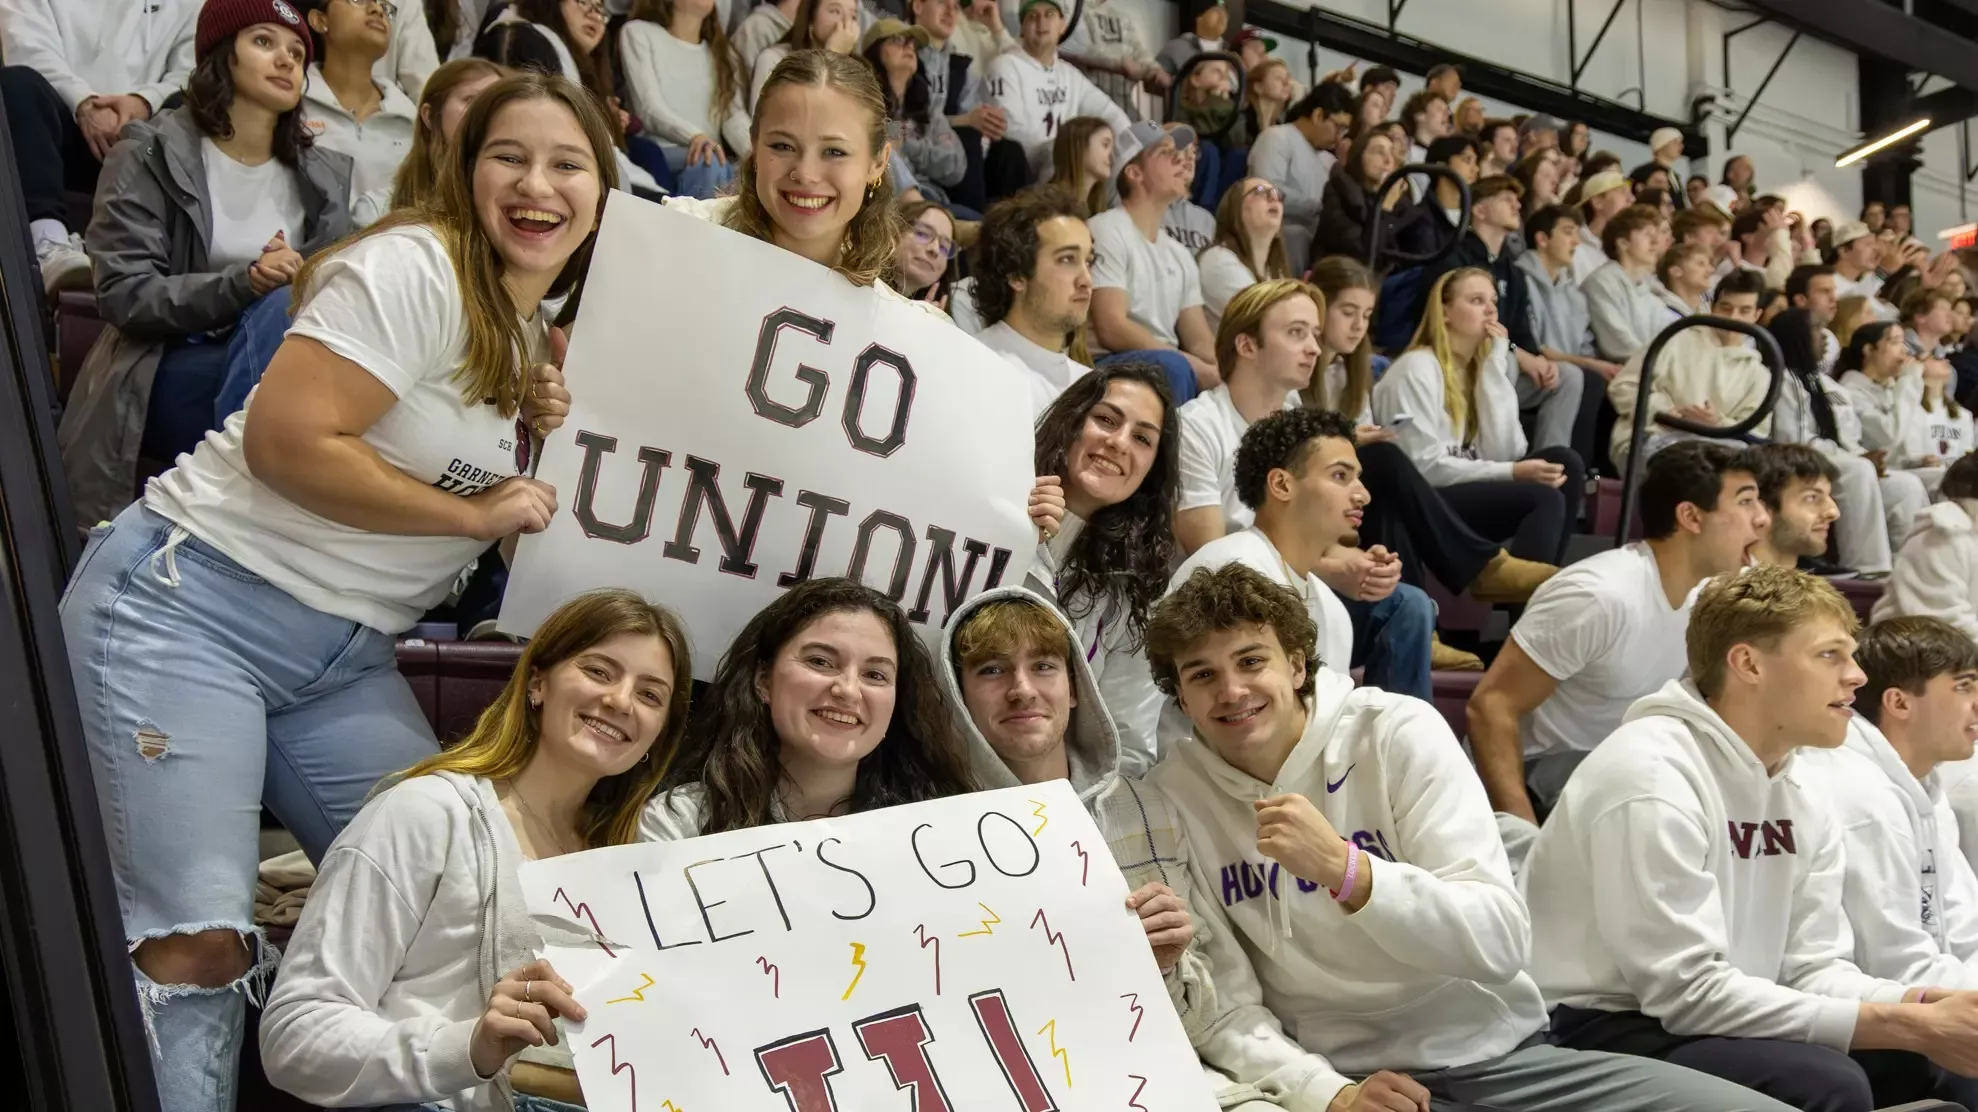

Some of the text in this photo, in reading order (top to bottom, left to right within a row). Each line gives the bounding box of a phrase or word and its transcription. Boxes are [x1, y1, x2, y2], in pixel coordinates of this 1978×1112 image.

[744, 306, 917, 459] GO
[634, 811, 1039, 950] LET'S GO
